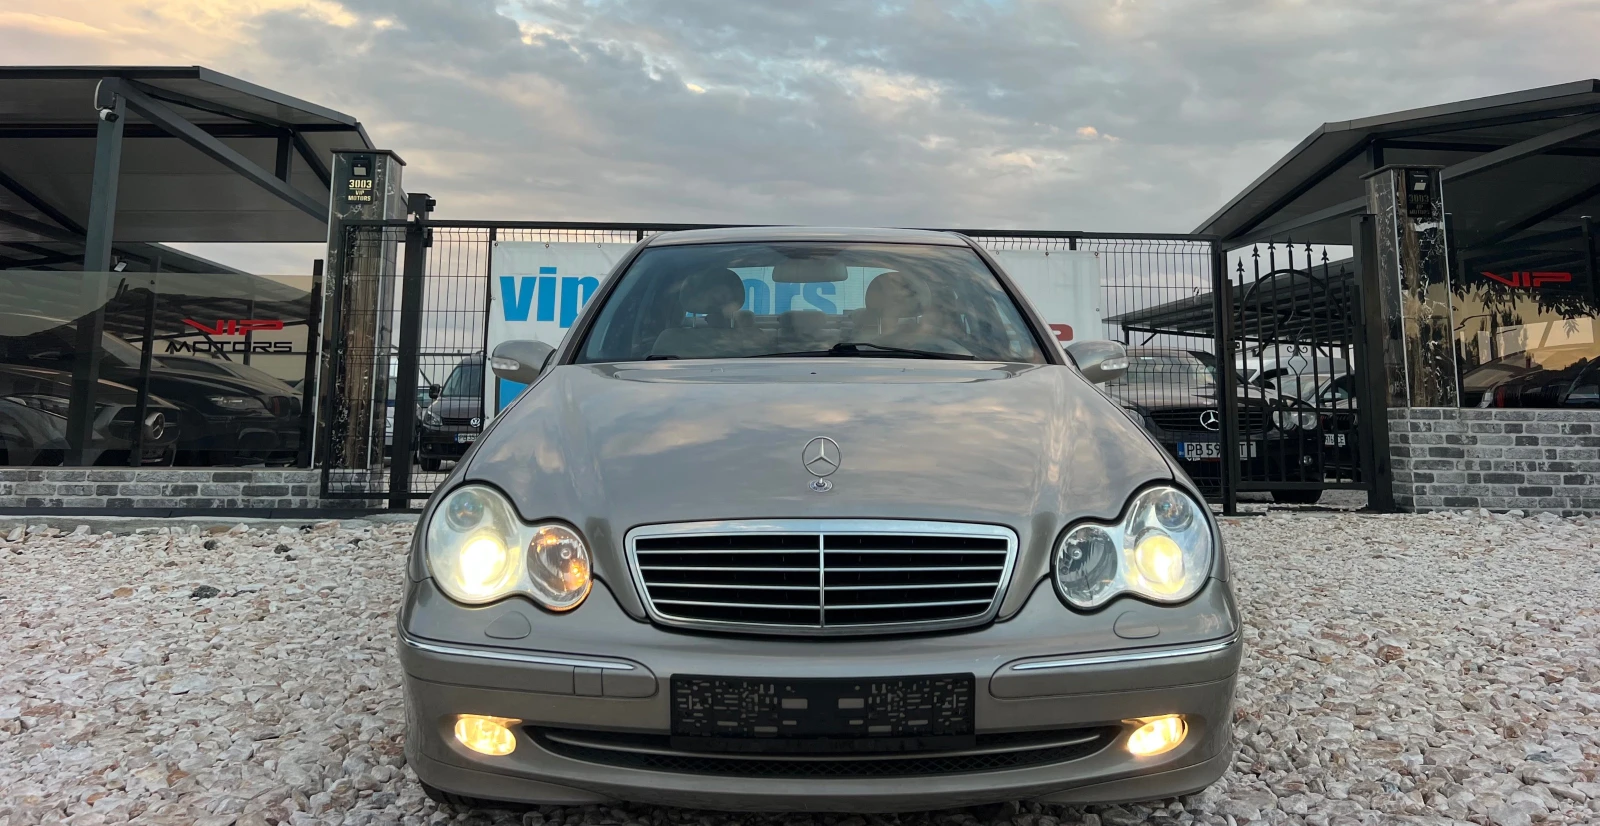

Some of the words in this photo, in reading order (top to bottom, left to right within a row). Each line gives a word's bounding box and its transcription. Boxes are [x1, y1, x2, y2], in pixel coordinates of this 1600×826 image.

[349, 179, 372, 188] 3003
[1480, 272, 1572, 286] VIP
[182, 319, 284, 335] VIP
[164, 341, 292, 352] MOTORS
[1186, 444, 1204, 456] PB
